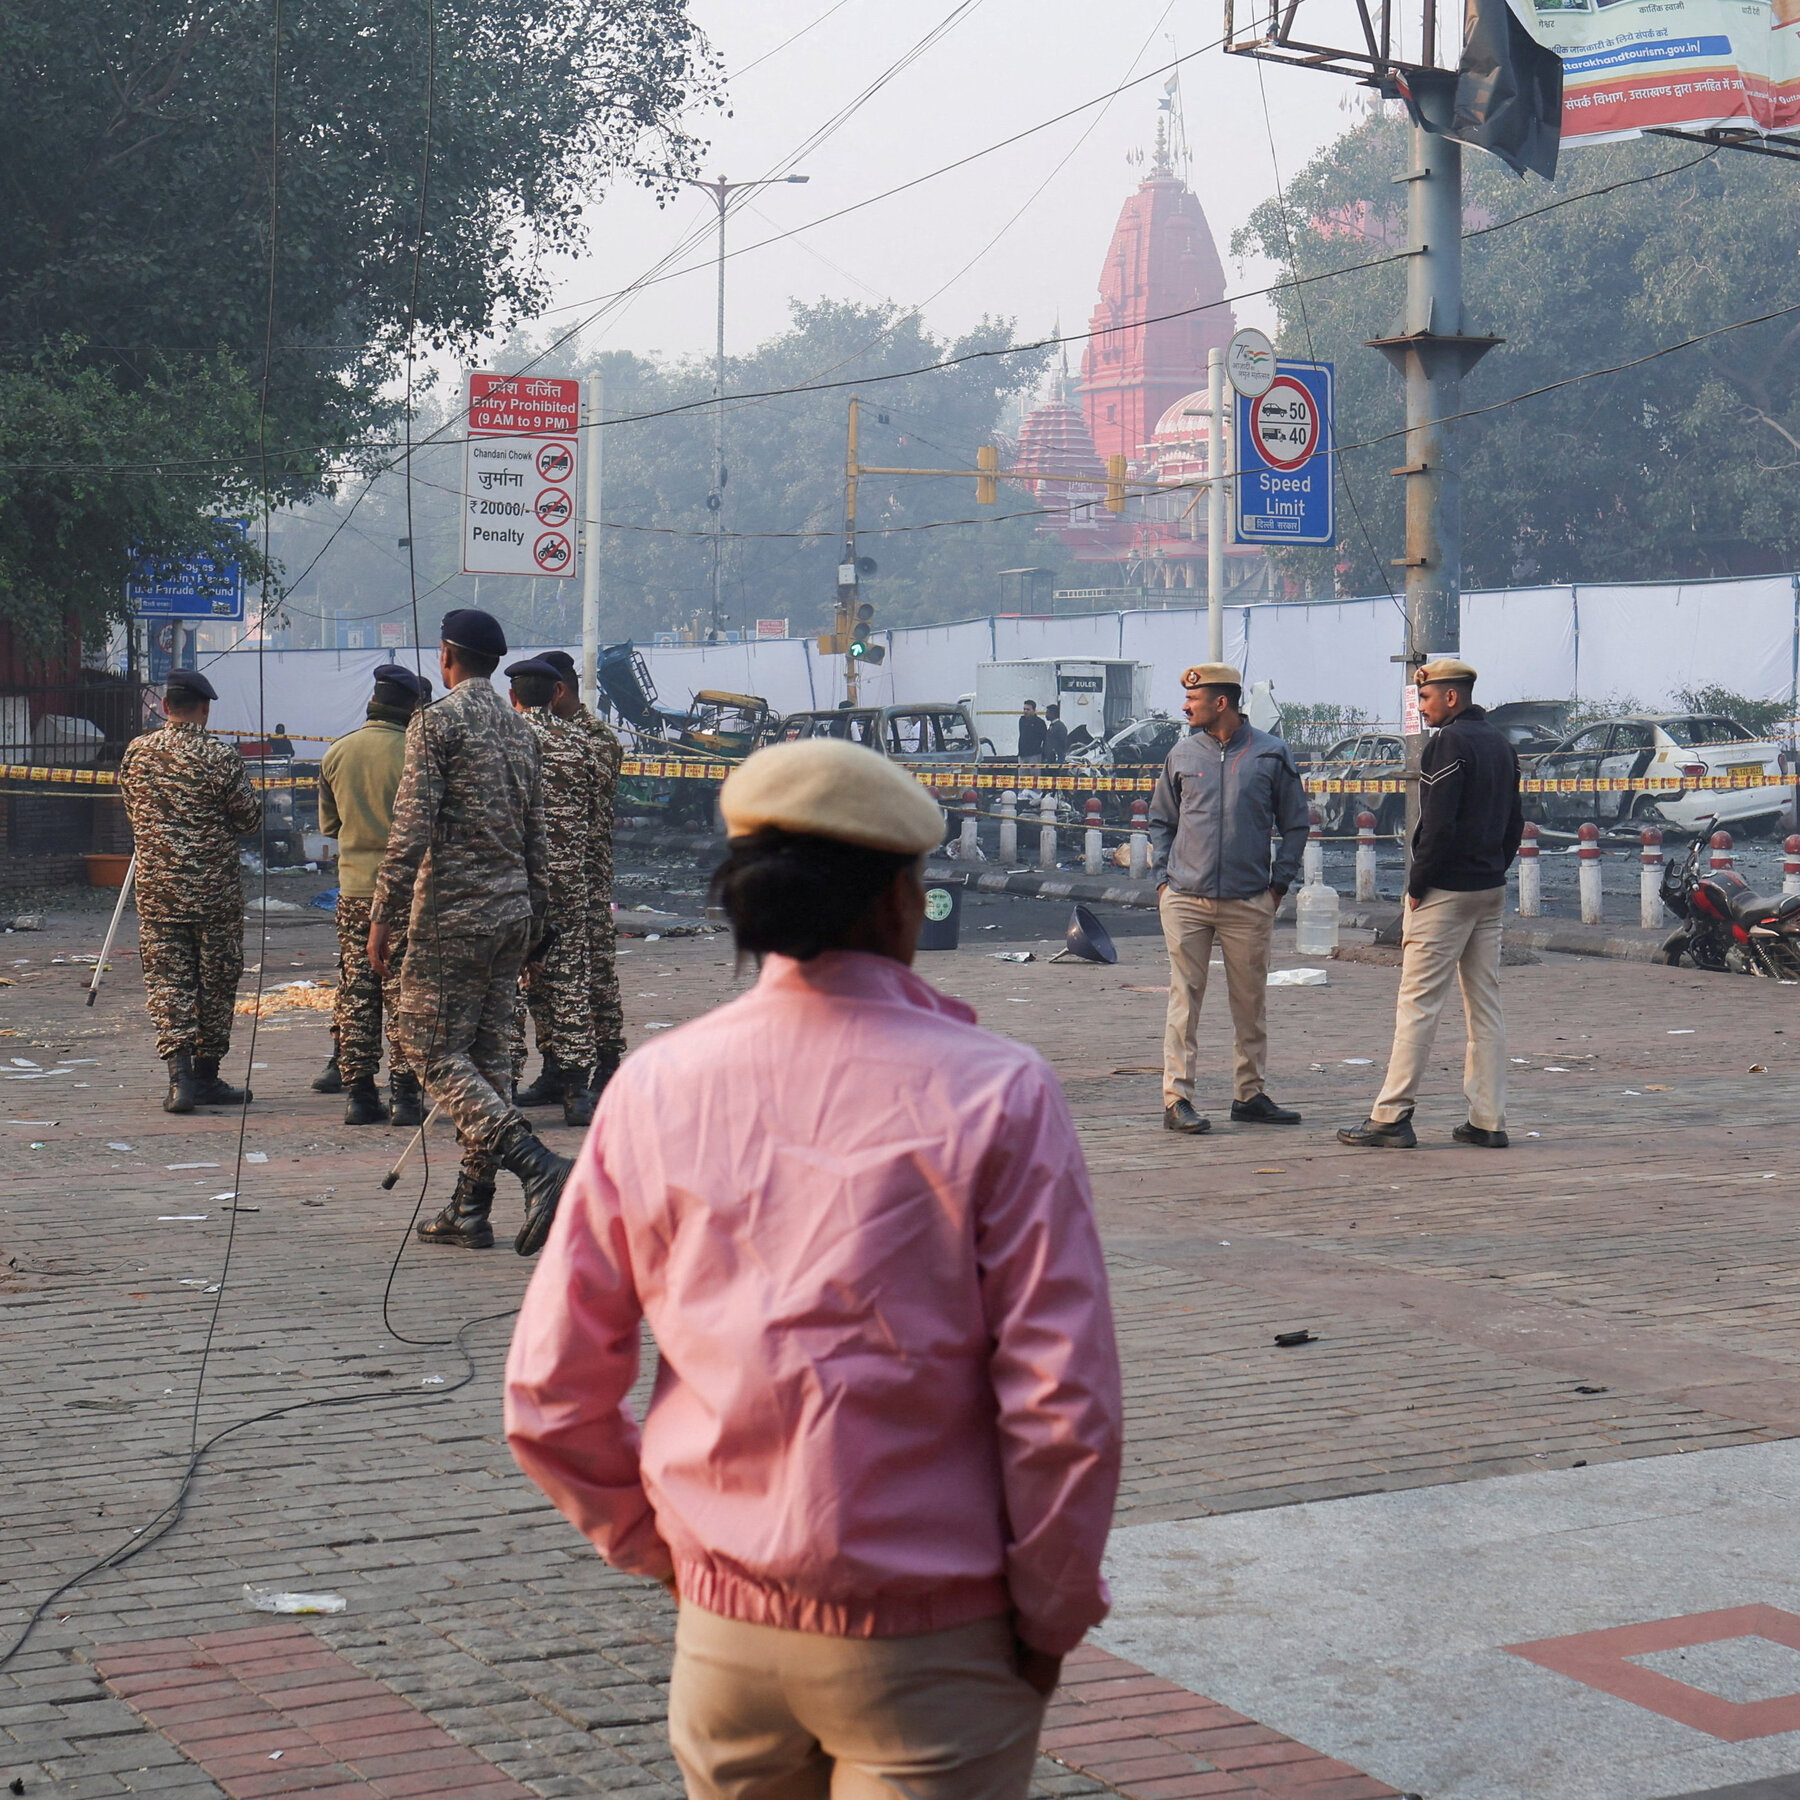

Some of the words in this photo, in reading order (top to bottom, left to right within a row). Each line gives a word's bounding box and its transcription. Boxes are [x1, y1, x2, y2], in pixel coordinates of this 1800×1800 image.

[1606, 39, 1615, 48] के
[1635, 29, 1655, 40] संपर्क
[1563, 95, 1591, 110] संपर्क
[1593, 91, 1627, 106] विभाग,
[1628, 85, 1672, 100] उत्तराखण्ड
[1673, 83, 1692, 97] द्वारा
[1693, 79, 1721, 92] जनहित
[488, 378, 518, 395] प्रवेश
[525, 380, 562, 398] वर्जित
[472, 395, 506, 412] Entry
[510, 398, 576, 414] Prohibited
[1290, 402, 1306, 420] 50
[478, 412, 490, 426] (9
[493, 414, 513, 426] AM
[518, 416, 530, 427] to
[534, 417, 541, 427] 9
[545, 417, 569, 432] PM)
[1289, 427, 1306, 445] 40
[473, 448, 507, 460] Chandani
[509, 450, 533, 461] Chowk
[478, 468, 524, 490] जुर्माना
[1260, 473, 1311, 494] Speed
[480, 500, 530, 516] 20000/-
[1266, 497, 1306, 516] Limit
[1277, 521, 1297, 530] सरकार
[473, 526, 525, 546] Penalty
